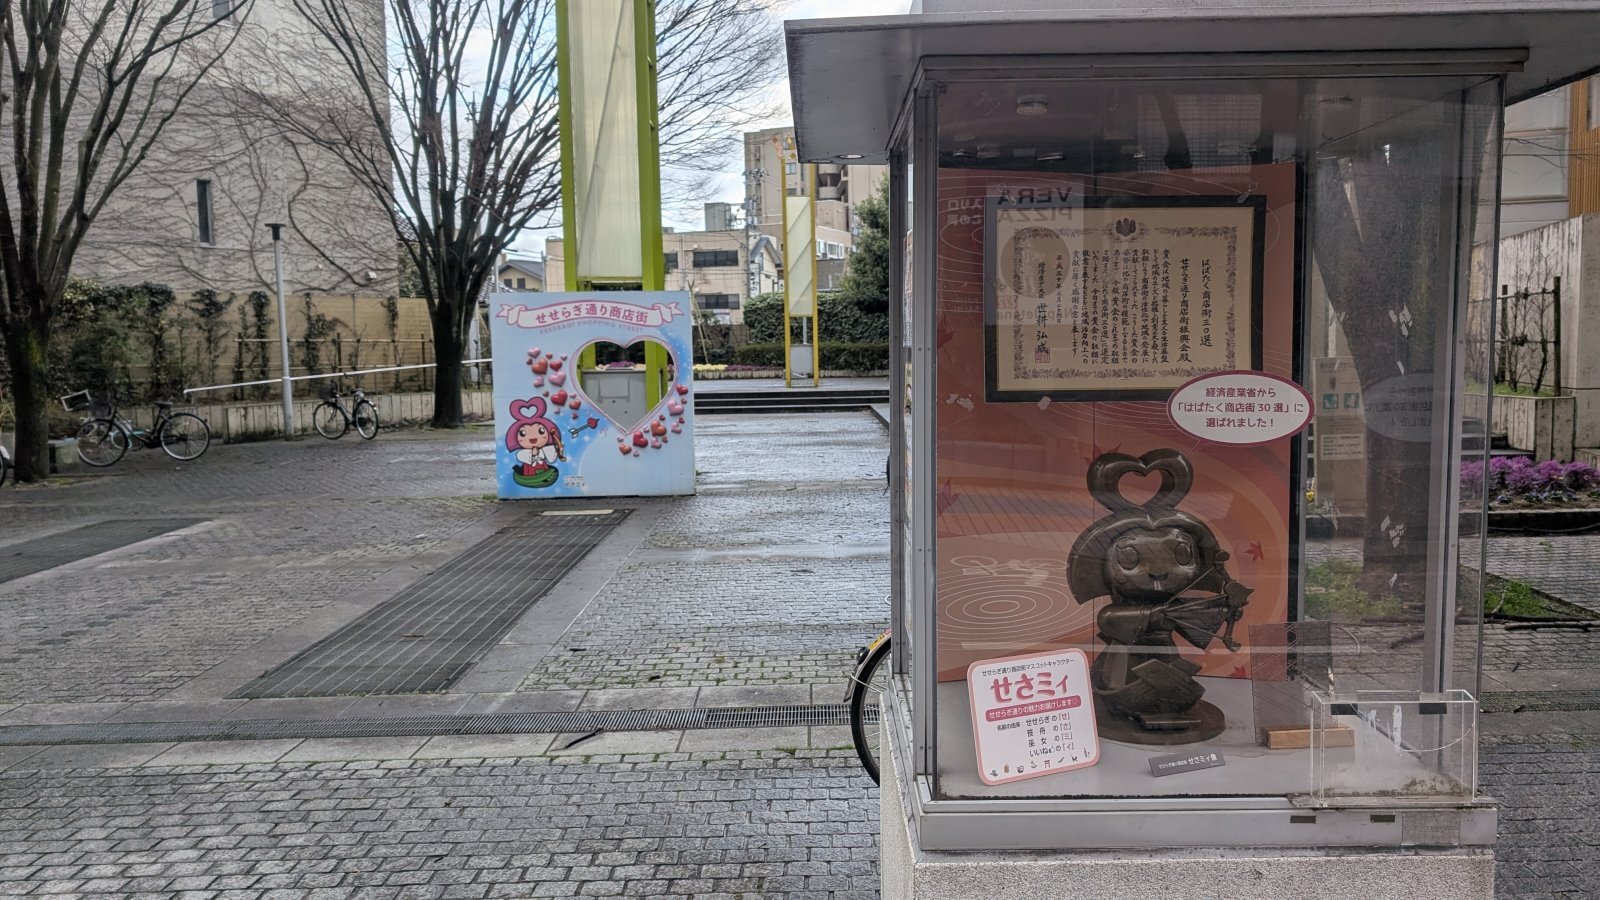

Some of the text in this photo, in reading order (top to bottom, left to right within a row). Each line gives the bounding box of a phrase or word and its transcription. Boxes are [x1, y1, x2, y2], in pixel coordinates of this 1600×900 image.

[536, 303, 649, 324] せせらぎ通り商店街
[1205, 387, 1277, 398] 経済産業省から
[990, 671, 1069, 704] せさミィ
